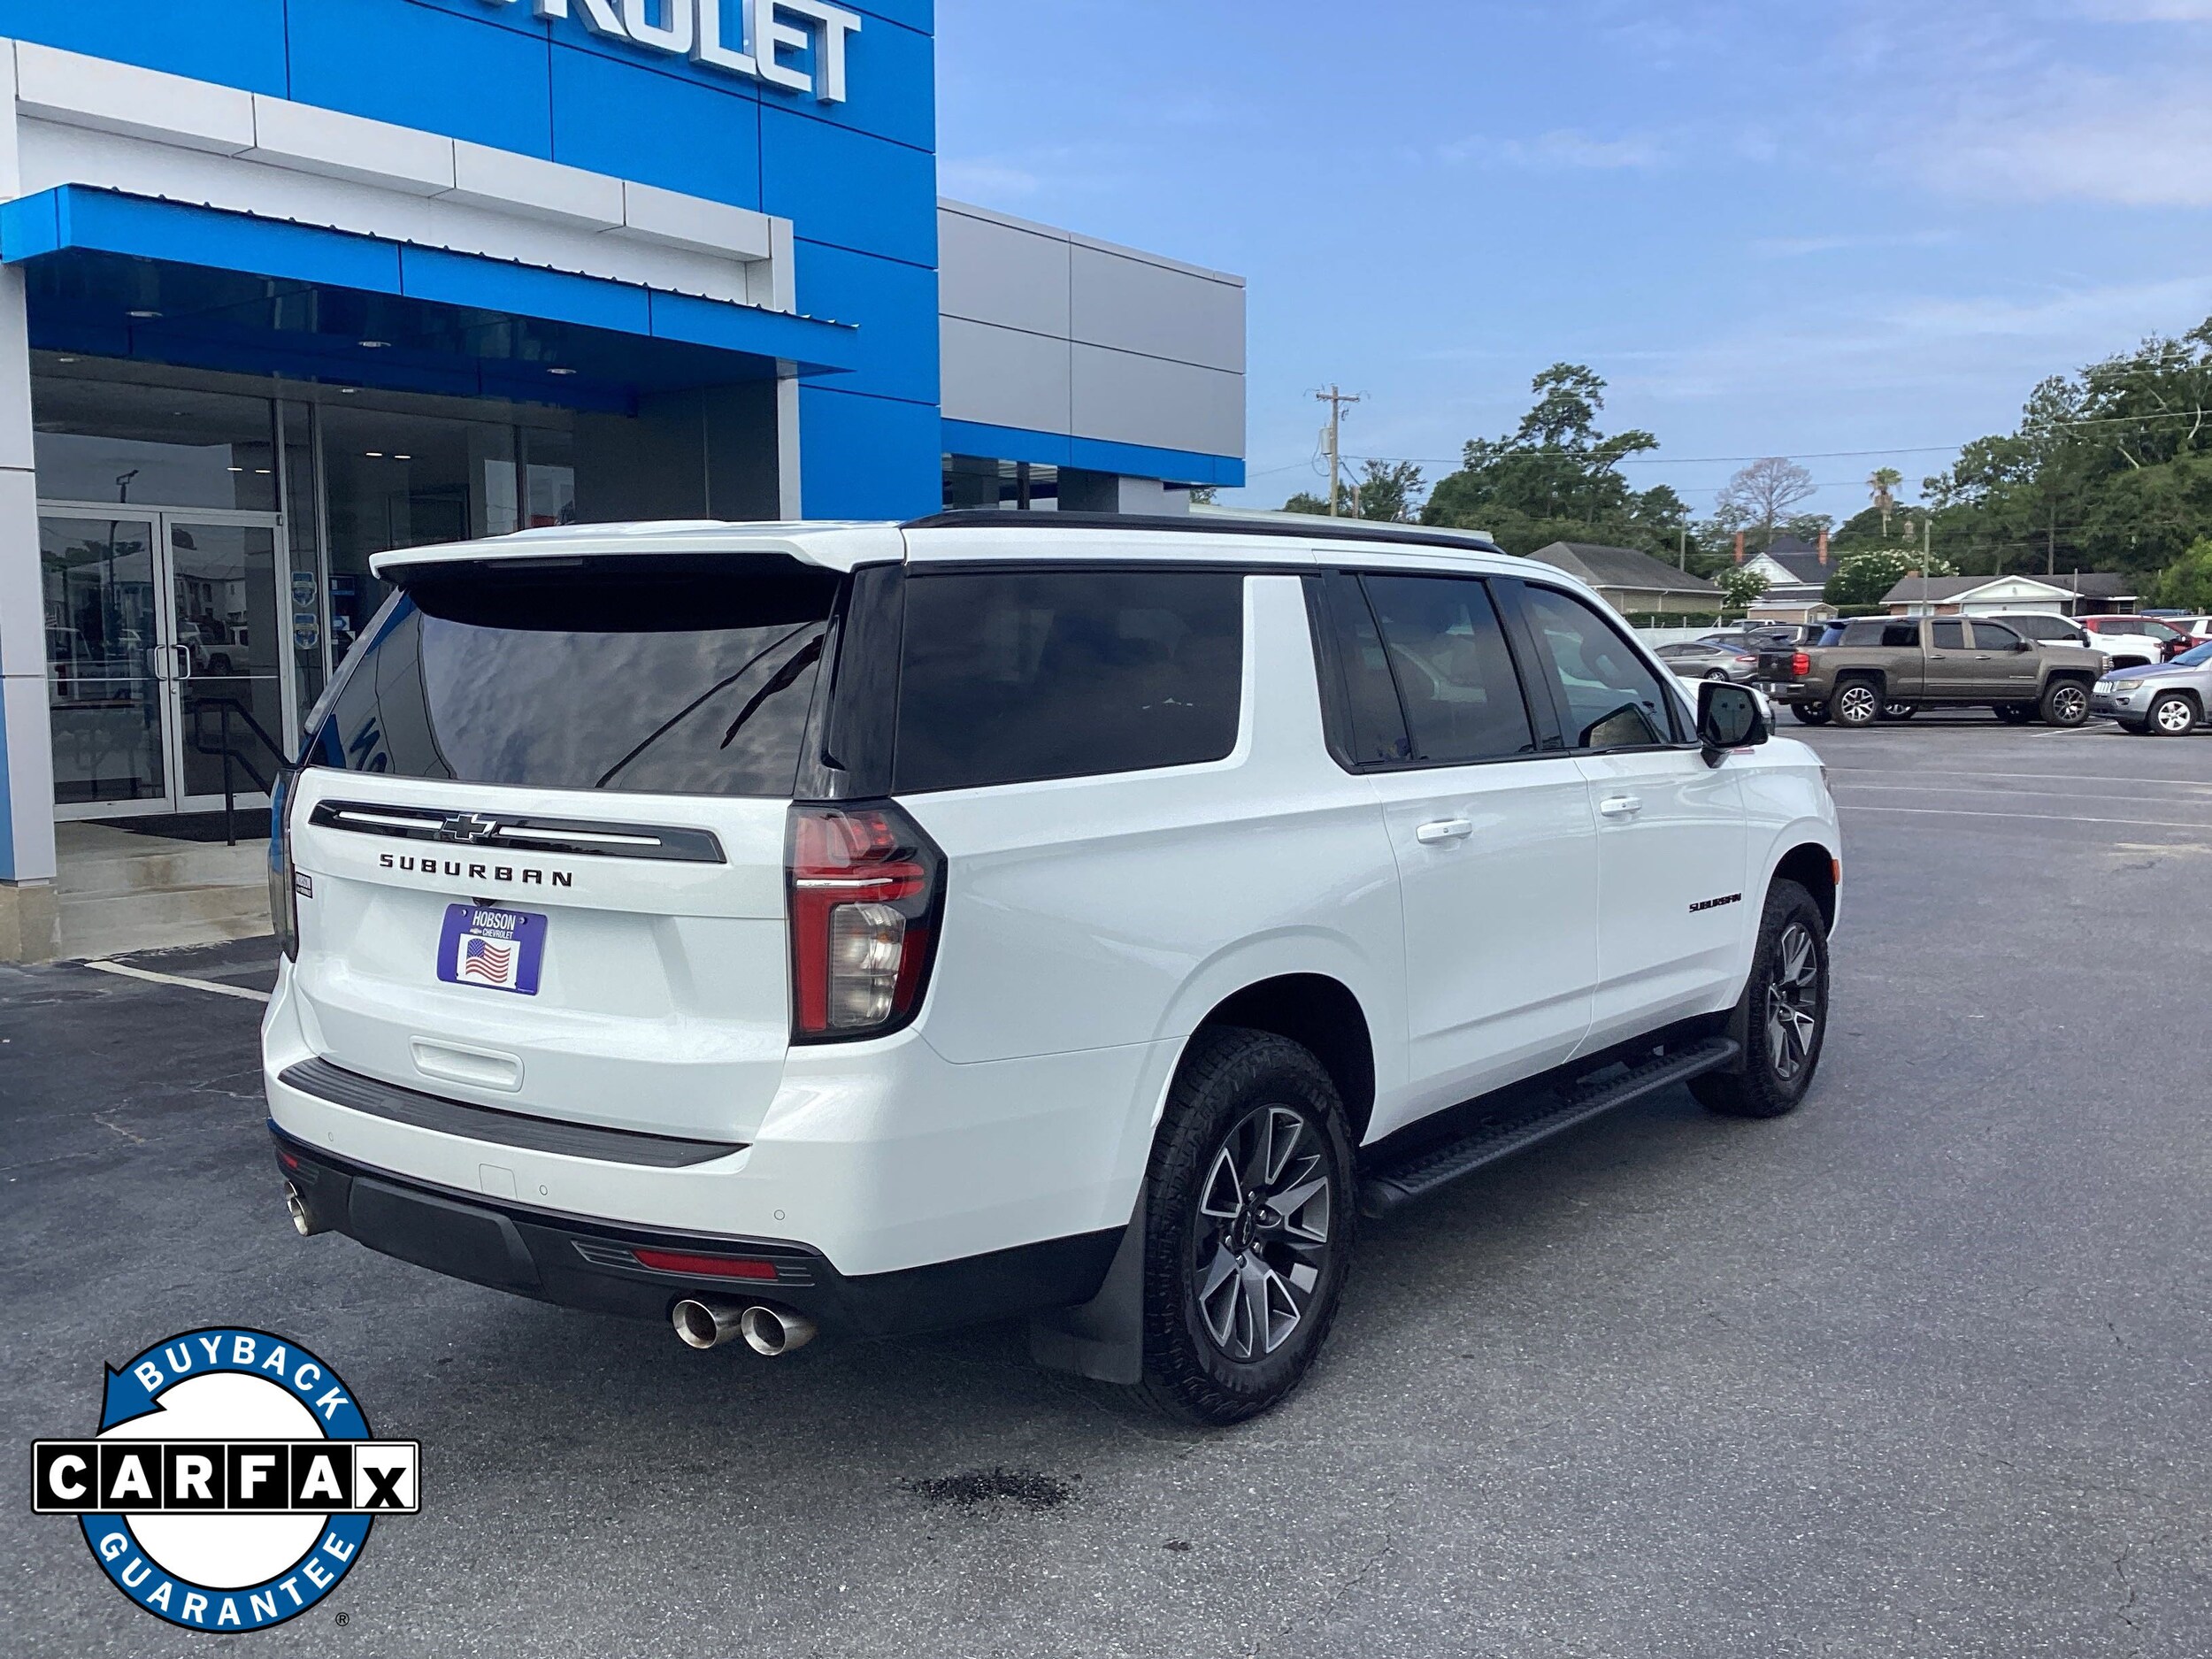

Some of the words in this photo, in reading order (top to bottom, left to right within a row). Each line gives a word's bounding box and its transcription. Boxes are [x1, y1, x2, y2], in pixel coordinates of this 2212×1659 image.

[379, 853, 574, 887] SUBURBAN
[1689, 893, 1742, 913] SUBURBAN
[472, 910, 516, 930] HOBSON
[482, 928, 513, 940] CHEVROLET
